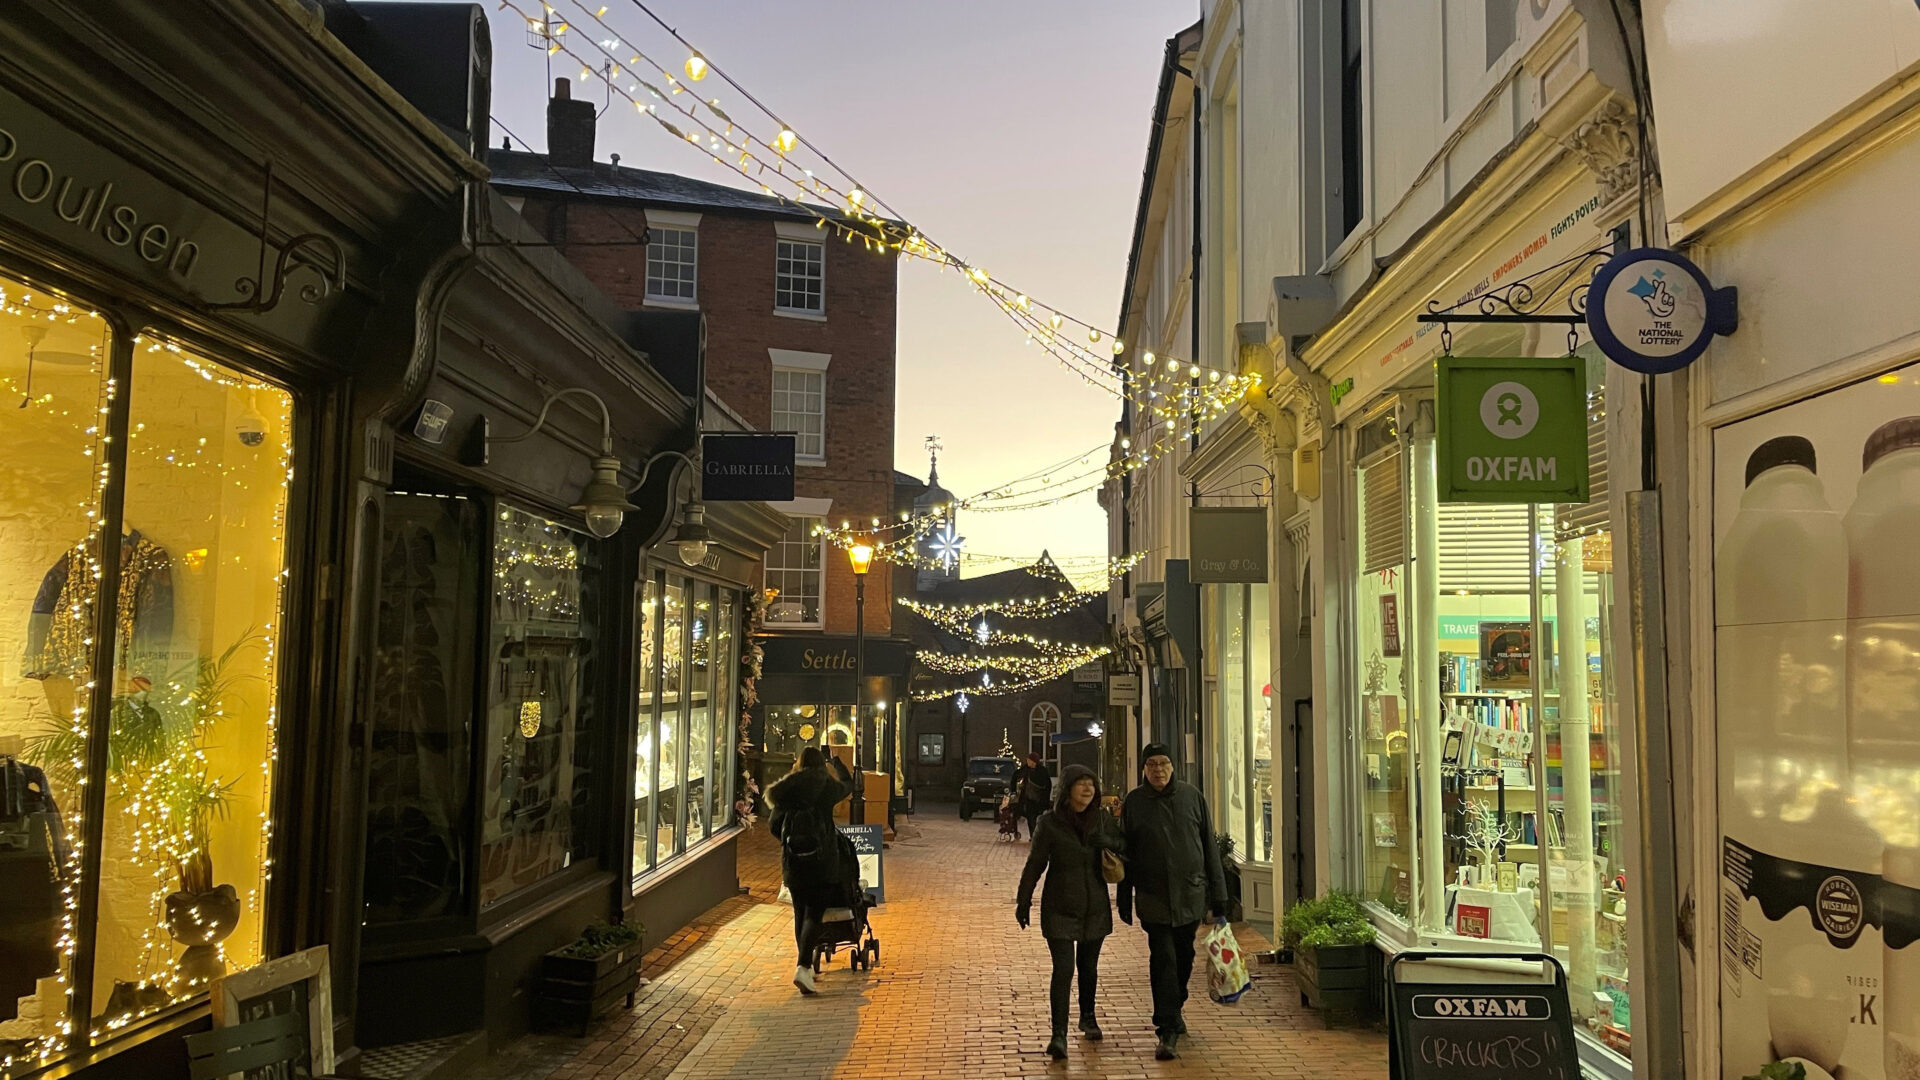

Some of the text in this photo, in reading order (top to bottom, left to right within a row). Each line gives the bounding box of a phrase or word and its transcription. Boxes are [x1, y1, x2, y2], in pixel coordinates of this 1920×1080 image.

[1492, 251, 1523, 283] EMPOWERS
[1522, 233, 1548, 260] WOMEN
[1550, 213, 1576, 240] FIGHTS
[1638, 329, 1684, 337] NATIONAL
[1654, 321, 1672, 329] THE
[1640, 337, 1681, 345] LOTTERY
[705, 460, 791, 476] GABRIELLA
[1466, 456, 1557, 481] OXFAM
[1200, 559, 1260, 573] Gray & Co.
[801, 648, 857, 670] Settle
[1825, 881, 1855, 898] ROBERT
[1821, 900, 1858, 914] WISEMAN
[1825, 916, 1855, 932] DAIRIES
[1434, 998, 1529, 1017] OXFAM
